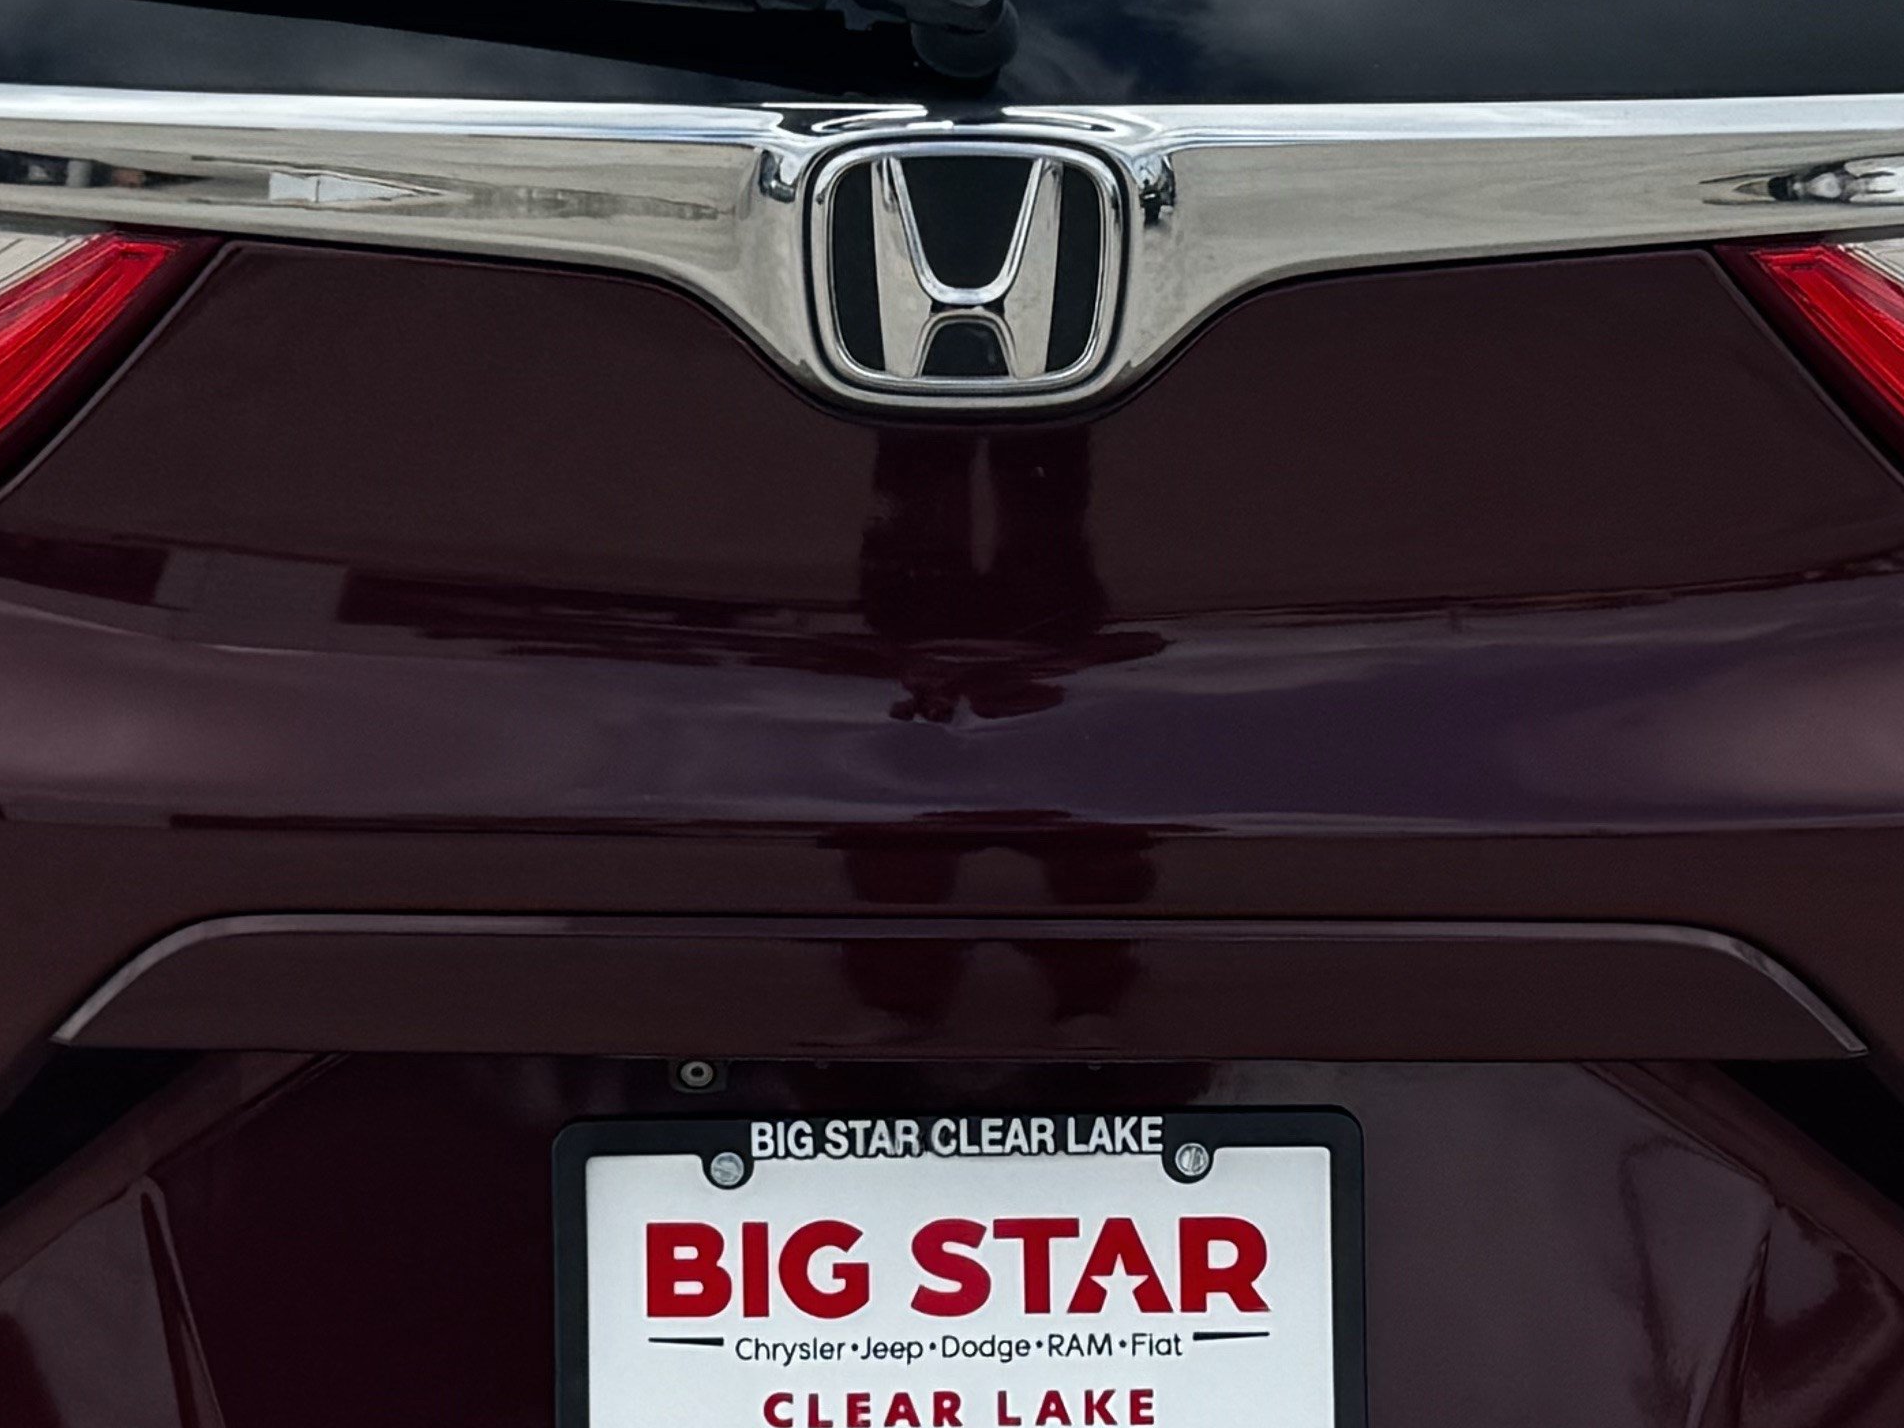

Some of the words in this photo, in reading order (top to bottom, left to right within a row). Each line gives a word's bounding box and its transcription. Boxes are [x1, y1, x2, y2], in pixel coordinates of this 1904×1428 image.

[750, 1121, 813, 1158] BIG
[824, 1119, 920, 1157] STAR
[931, 1117, 1055, 1156] CLEAR
[1066, 1116, 1164, 1155] LAKE
[645, 1220, 870, 1320] BIG
[910, 1216, 1271, 1318] STAR
[762, 1390, 963, 1428] CLEAR
[996, 1389, 1156, 1427] LAKE
